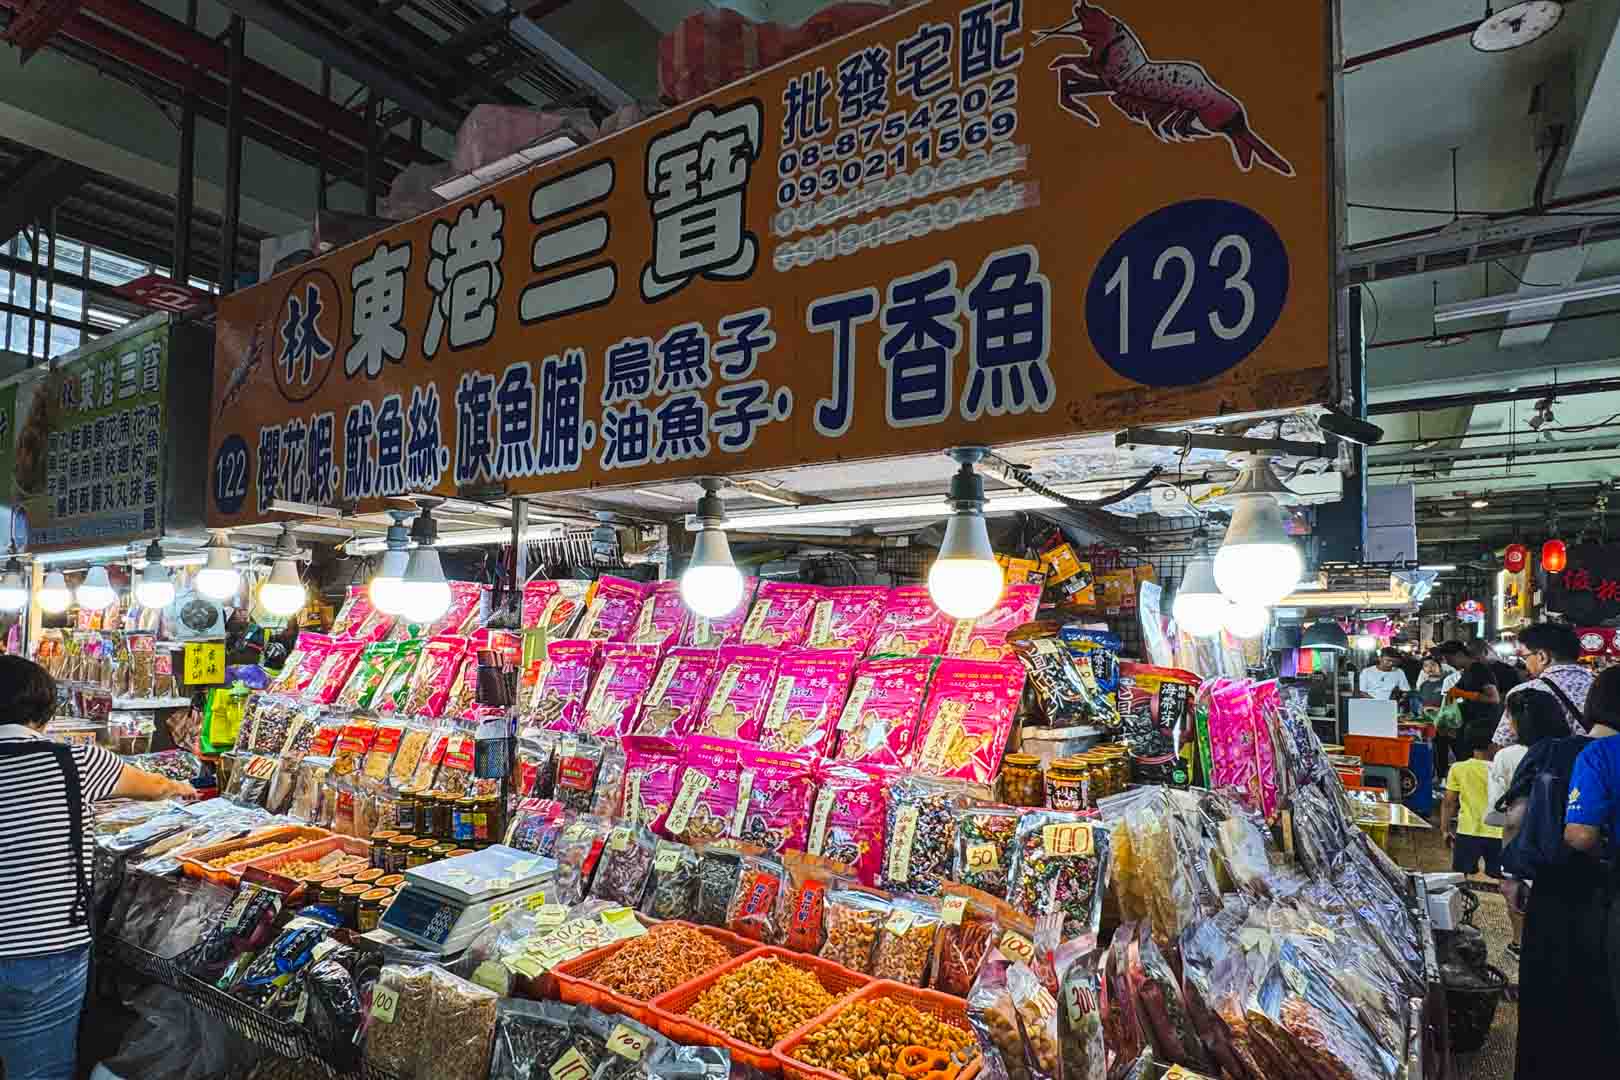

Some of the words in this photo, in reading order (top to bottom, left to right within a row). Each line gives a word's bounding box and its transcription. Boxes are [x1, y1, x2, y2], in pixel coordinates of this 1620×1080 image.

[782, 0, 1023, 147] 批發宅配
[778, 76, 1017, 177] 08-8754202
[778, 108, 1017, 207] 0930211569
[279, 282, 333, 385] 林
[344, 97, 764, 380] 東港三寶
[1105, 234, 1256, 355] 123
[807, 245, 1056, 436] 丁香魚
[601, 380, 768, 470] 油魚子
[216, 450, 247, 498] 122
[970, 849, 992, 866] 50
[1001, 936, 1032, 957] 100
[373, 986, 394, 1010] 100
[617, 1033, 641, 1050] 100
[1072, 986, 1096, 1022] 300
